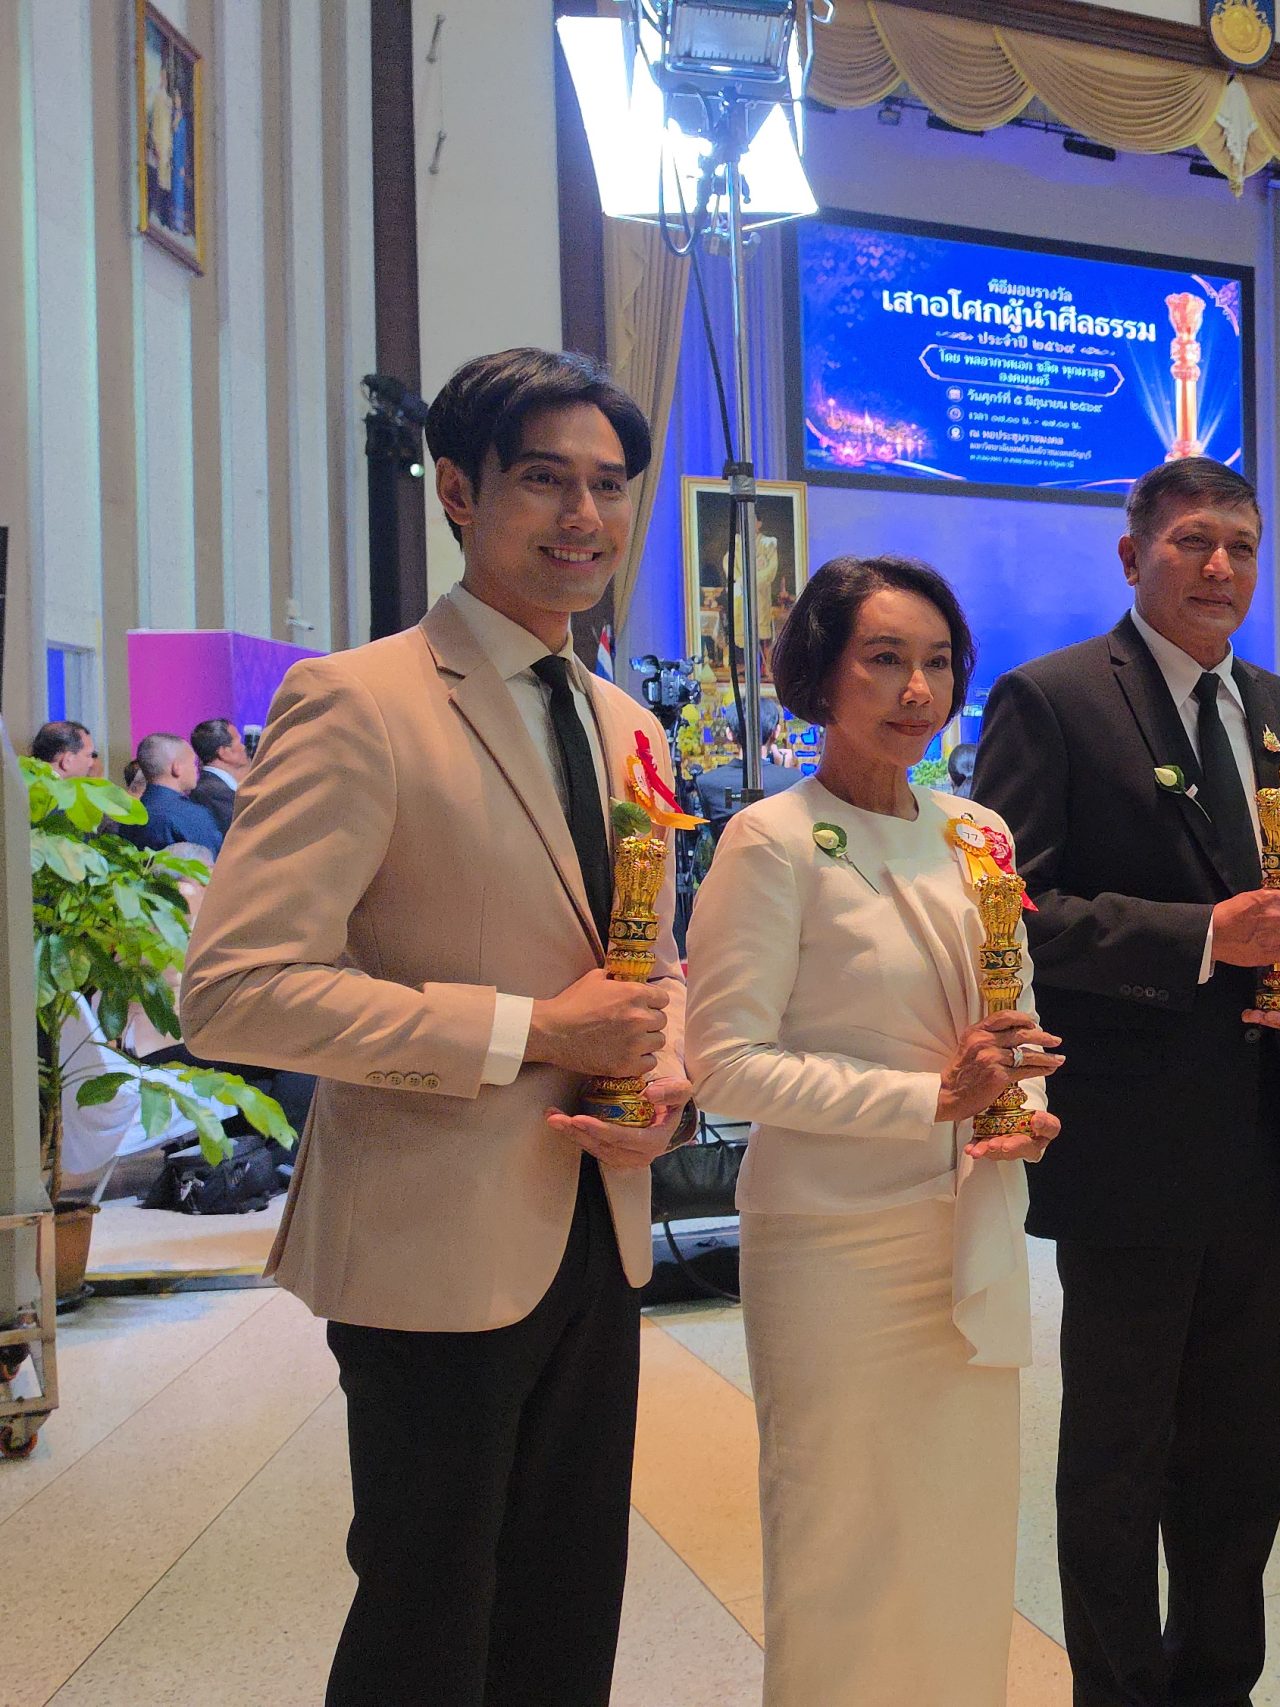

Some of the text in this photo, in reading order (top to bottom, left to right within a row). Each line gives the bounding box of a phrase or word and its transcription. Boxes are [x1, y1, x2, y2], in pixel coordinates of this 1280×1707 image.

[987, 278, 1073, 302] พิธีมอบรางวัล
[881, 288, 1157, 342] เสาอโศกผู้นำศีลธรรม
[977, 331, 1028, 349] ประจำปี
[939, 347, 961, 364] โดย
